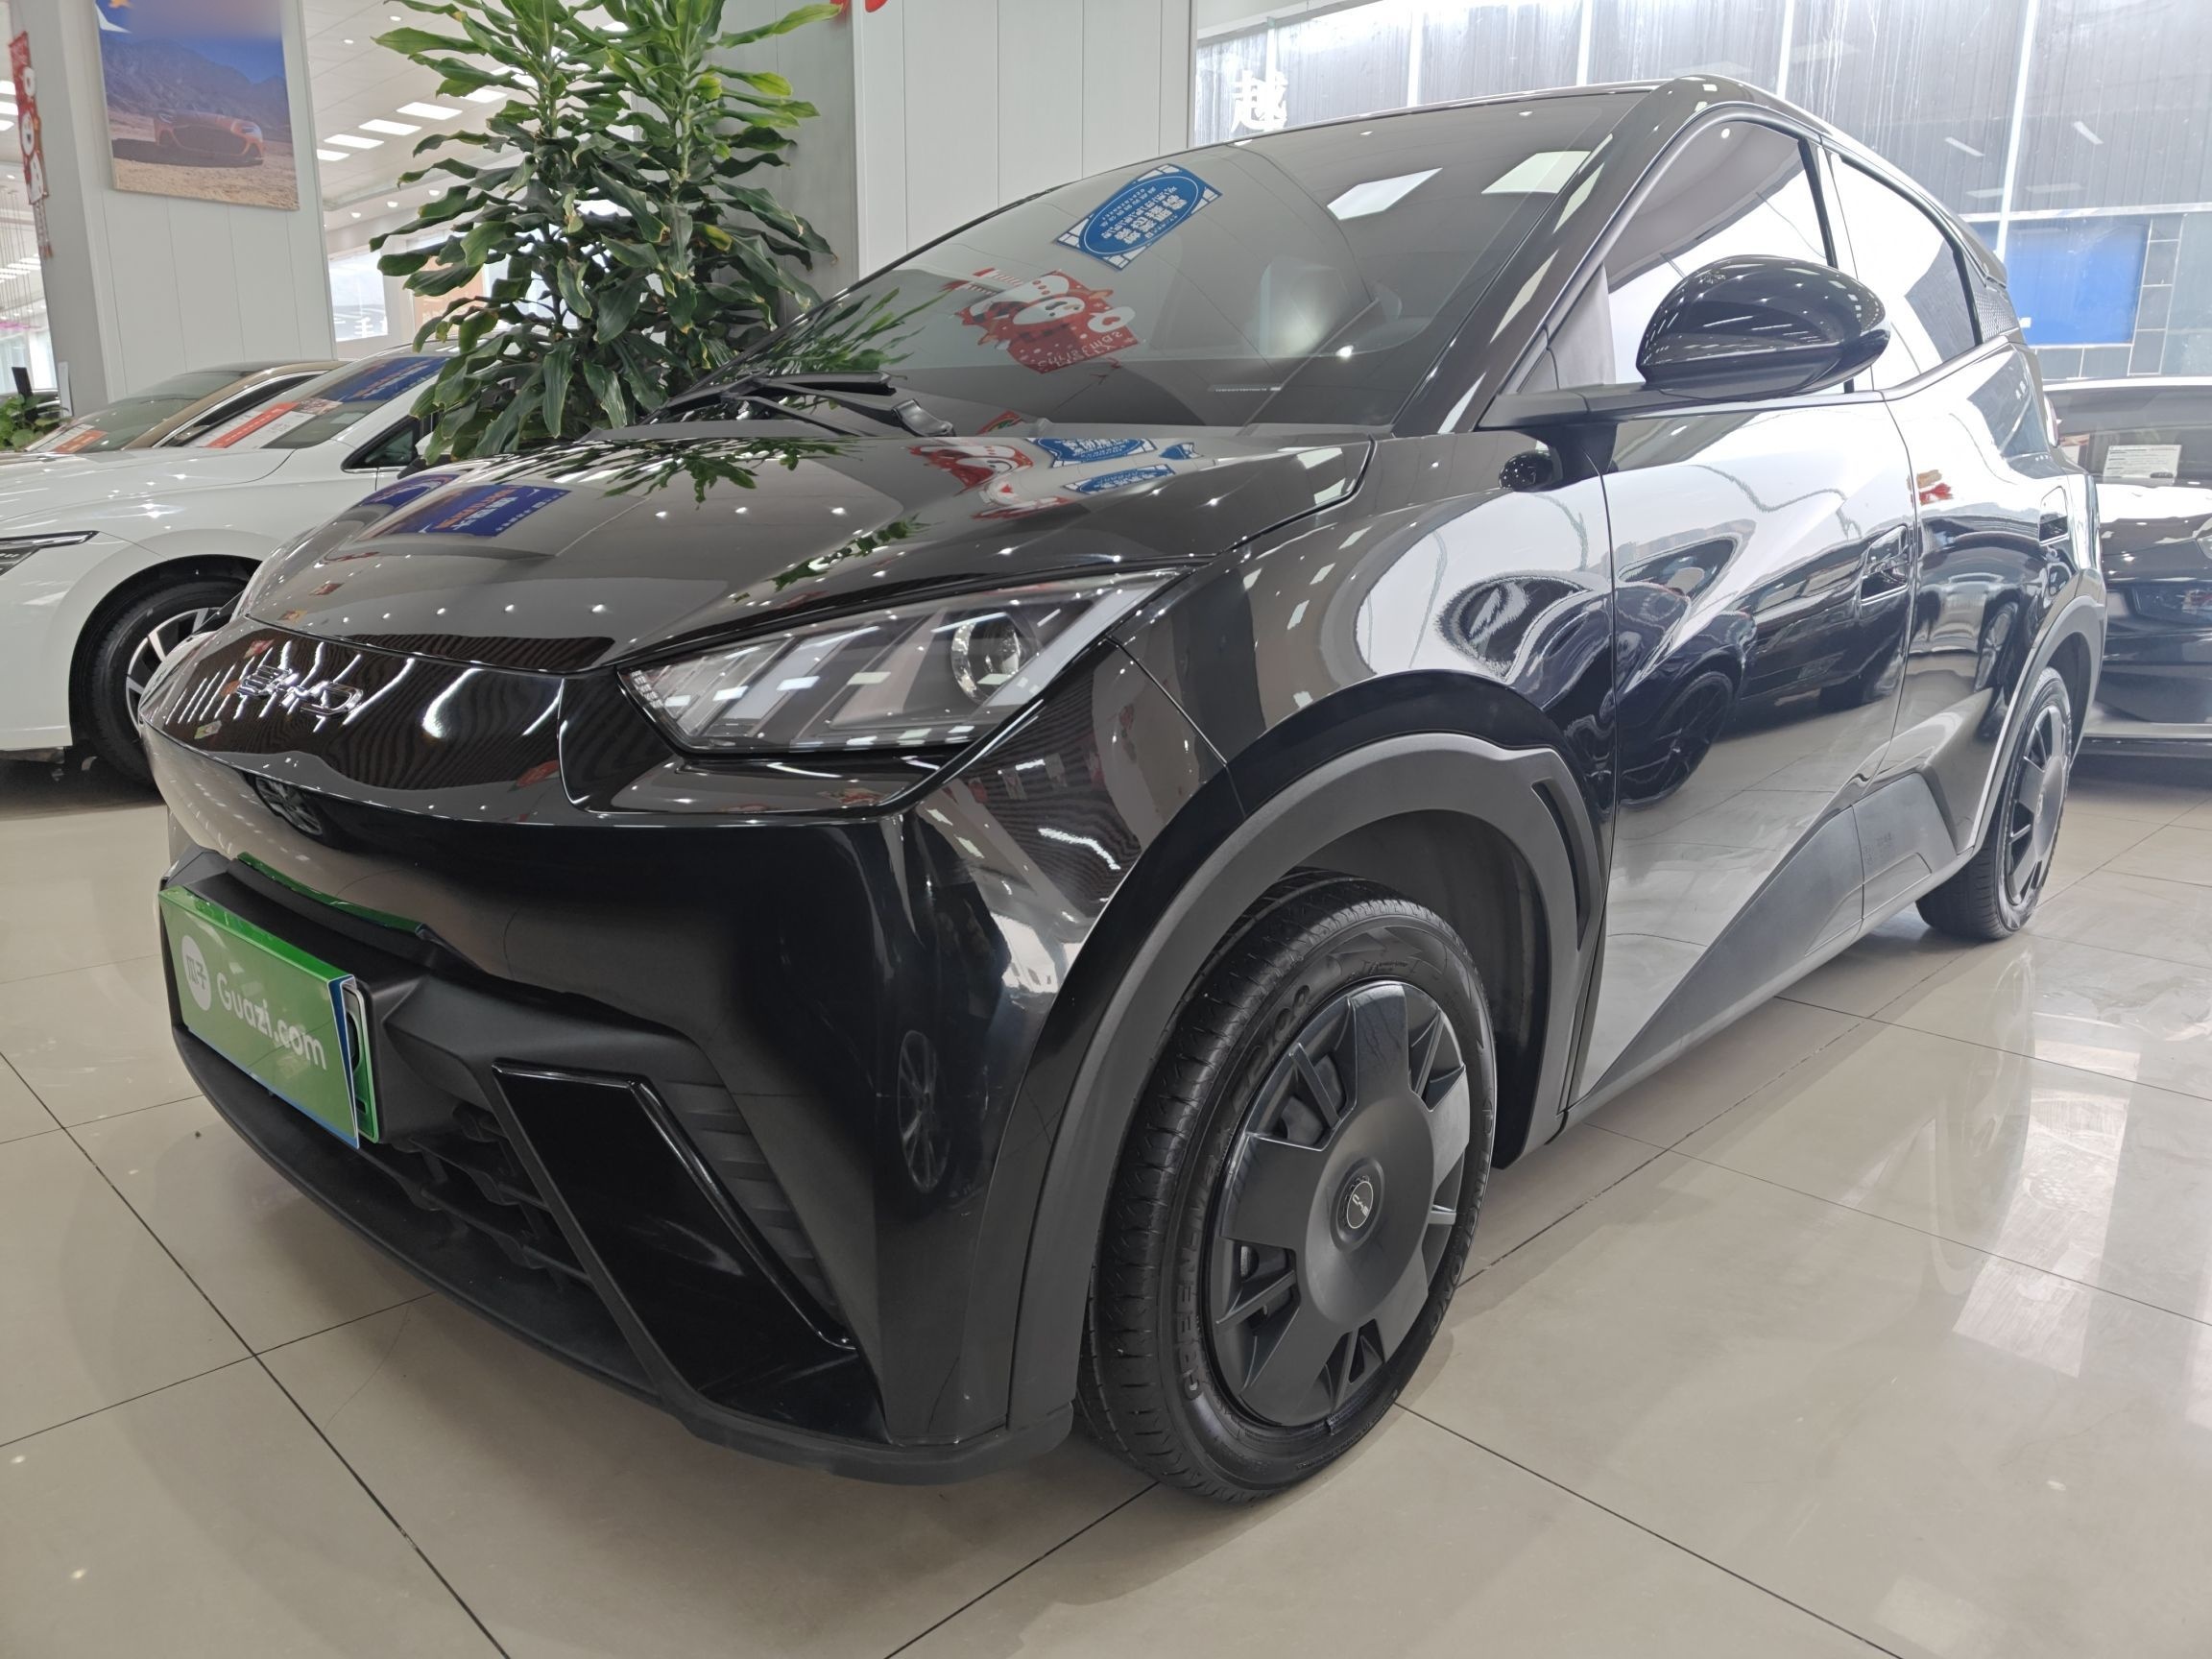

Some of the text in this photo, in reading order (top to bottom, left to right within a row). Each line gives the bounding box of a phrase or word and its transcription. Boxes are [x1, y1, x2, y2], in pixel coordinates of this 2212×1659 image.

[237, 664, 364, 717] BYD
[185, 951, 207, 990] 瓜子
[216, 972, 327, 1071] Guazi.com
